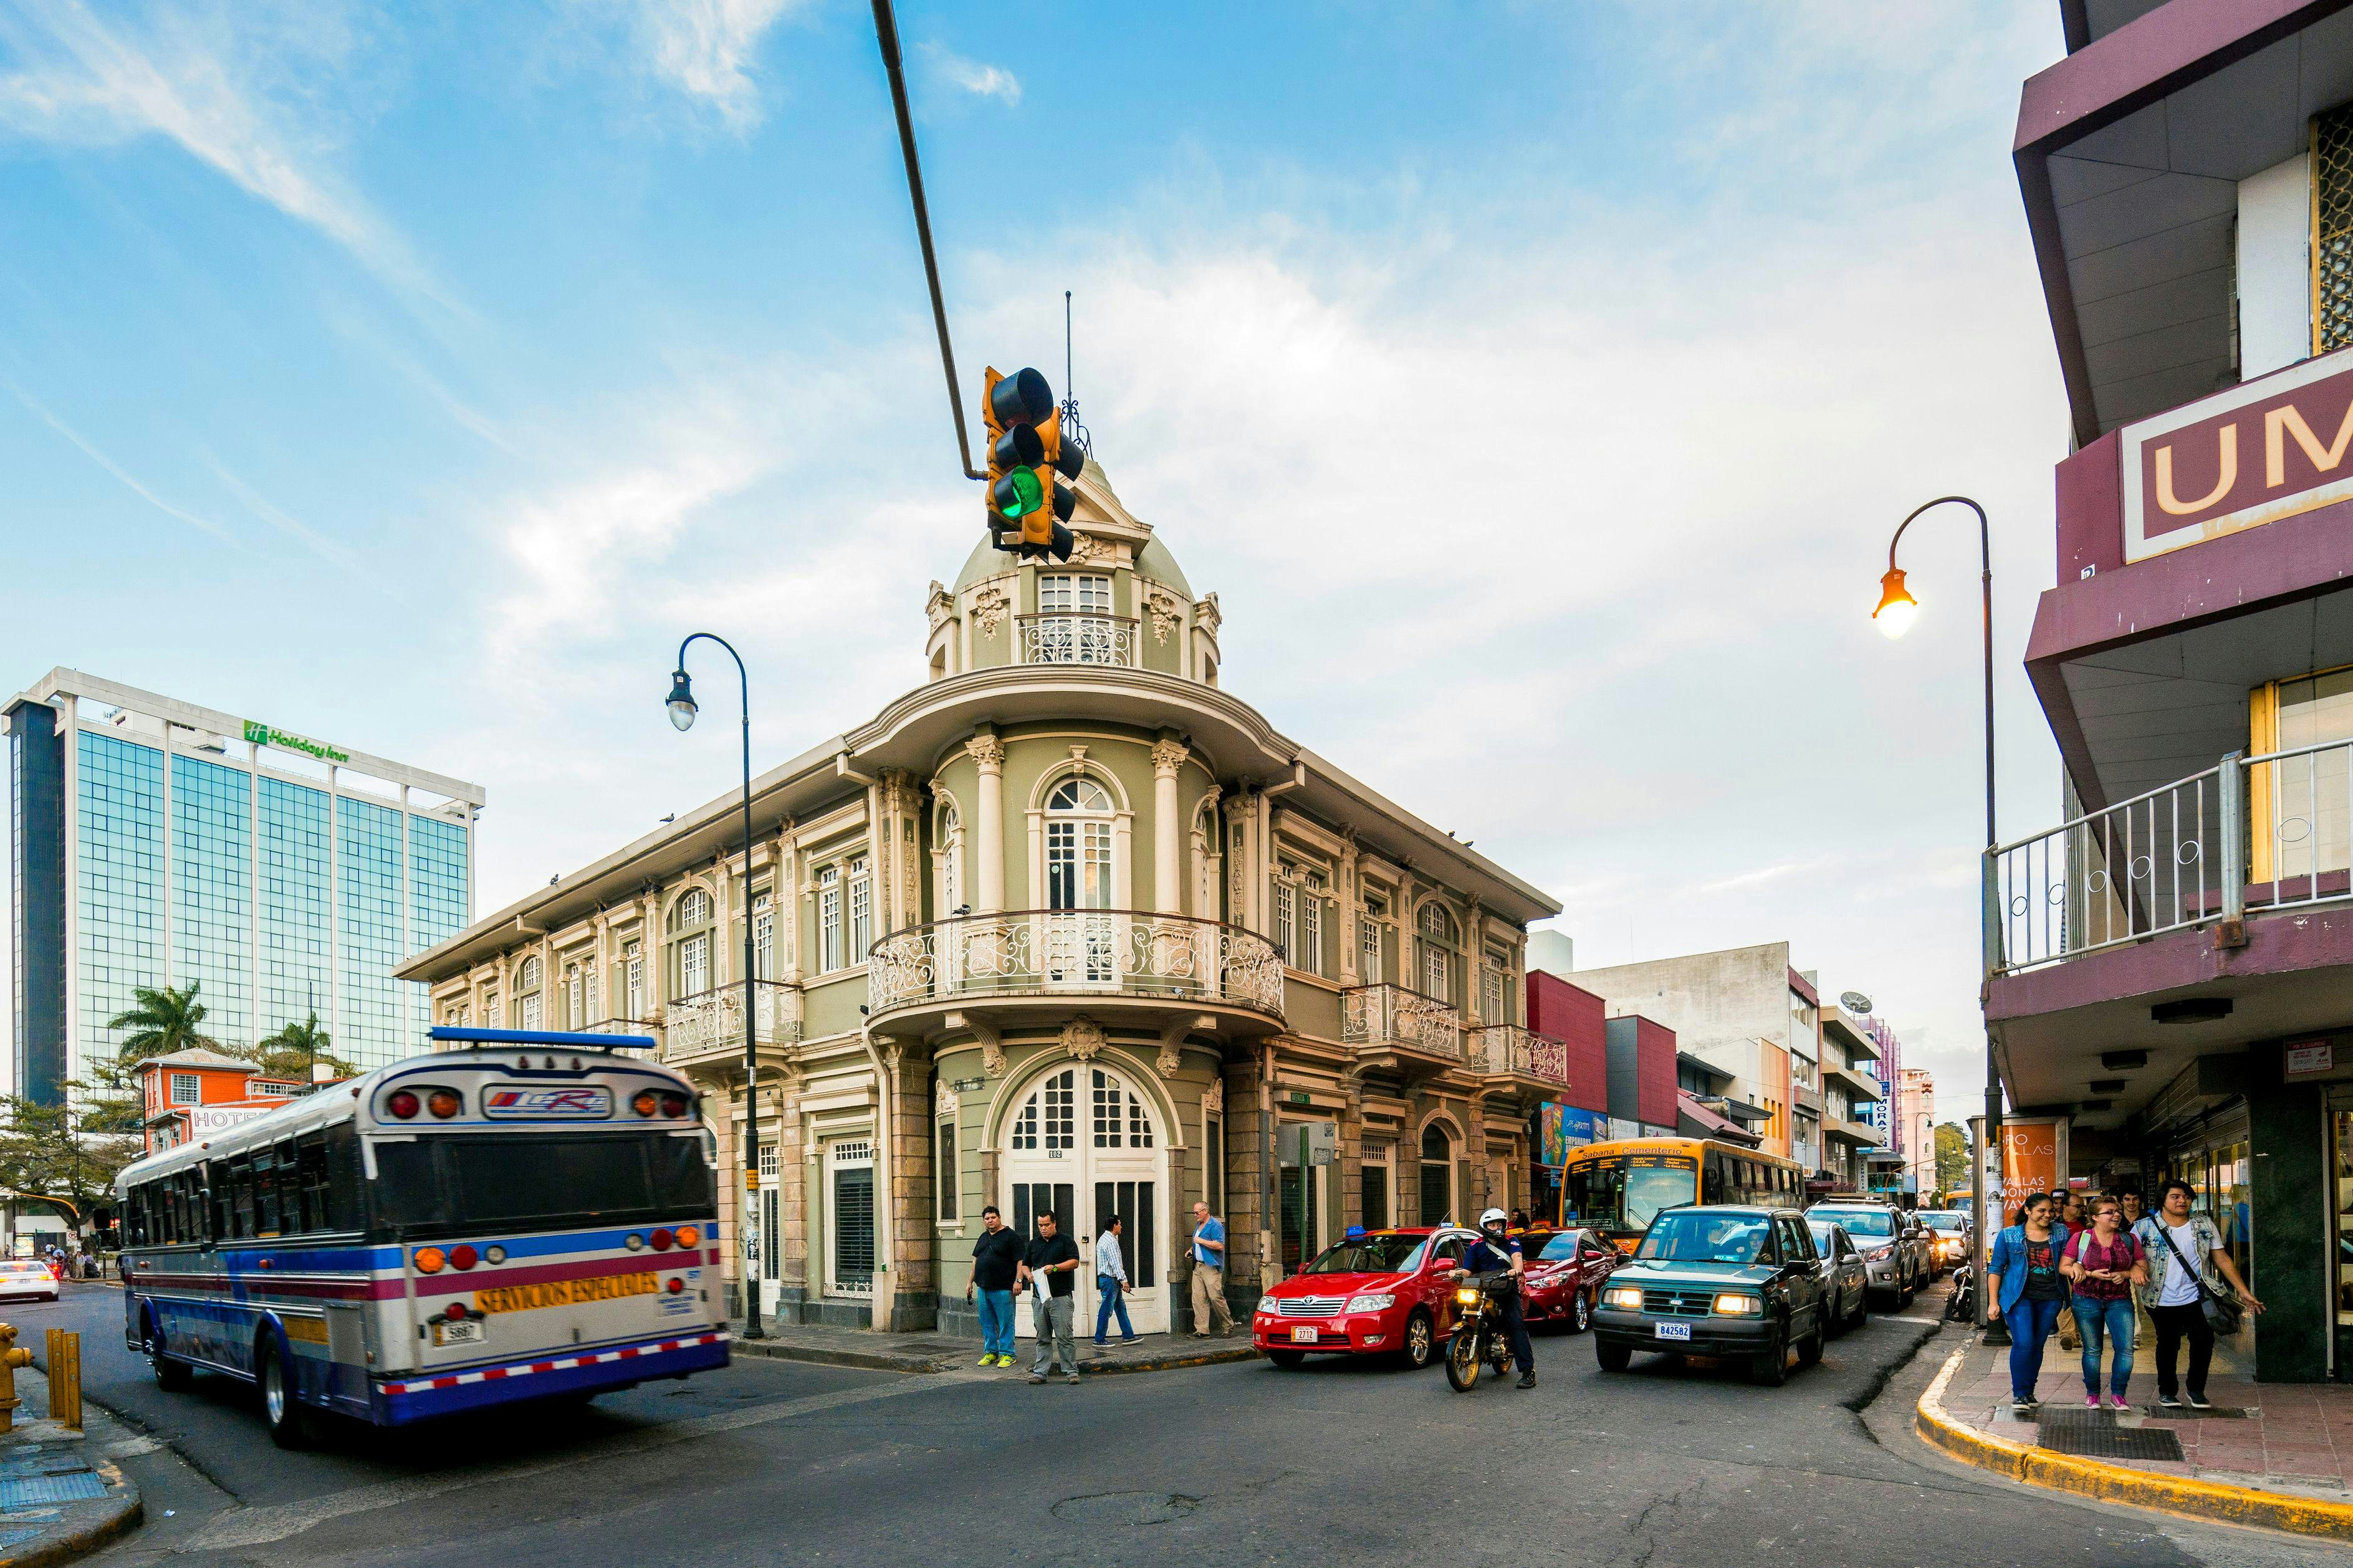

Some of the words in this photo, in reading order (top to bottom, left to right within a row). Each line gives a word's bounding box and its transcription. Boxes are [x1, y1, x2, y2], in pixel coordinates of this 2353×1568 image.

[269, 729, 325, 758] Holiday
[326, 745, 350, 762] Inn
[1582, 1149, 1614, 1159] Sabana
[1622, 1147, 1682, 1155] Cementerio
[2003, 1145, 2053, 1155] ALLAS
[478, 1282, 569, 1313] SERVICIOS
[572, 1272, 658, 1302] ESPECIALES
[1299, 1331, 1313, 1339] 2712
[1661, 1326, 1688, 1336] 842582
